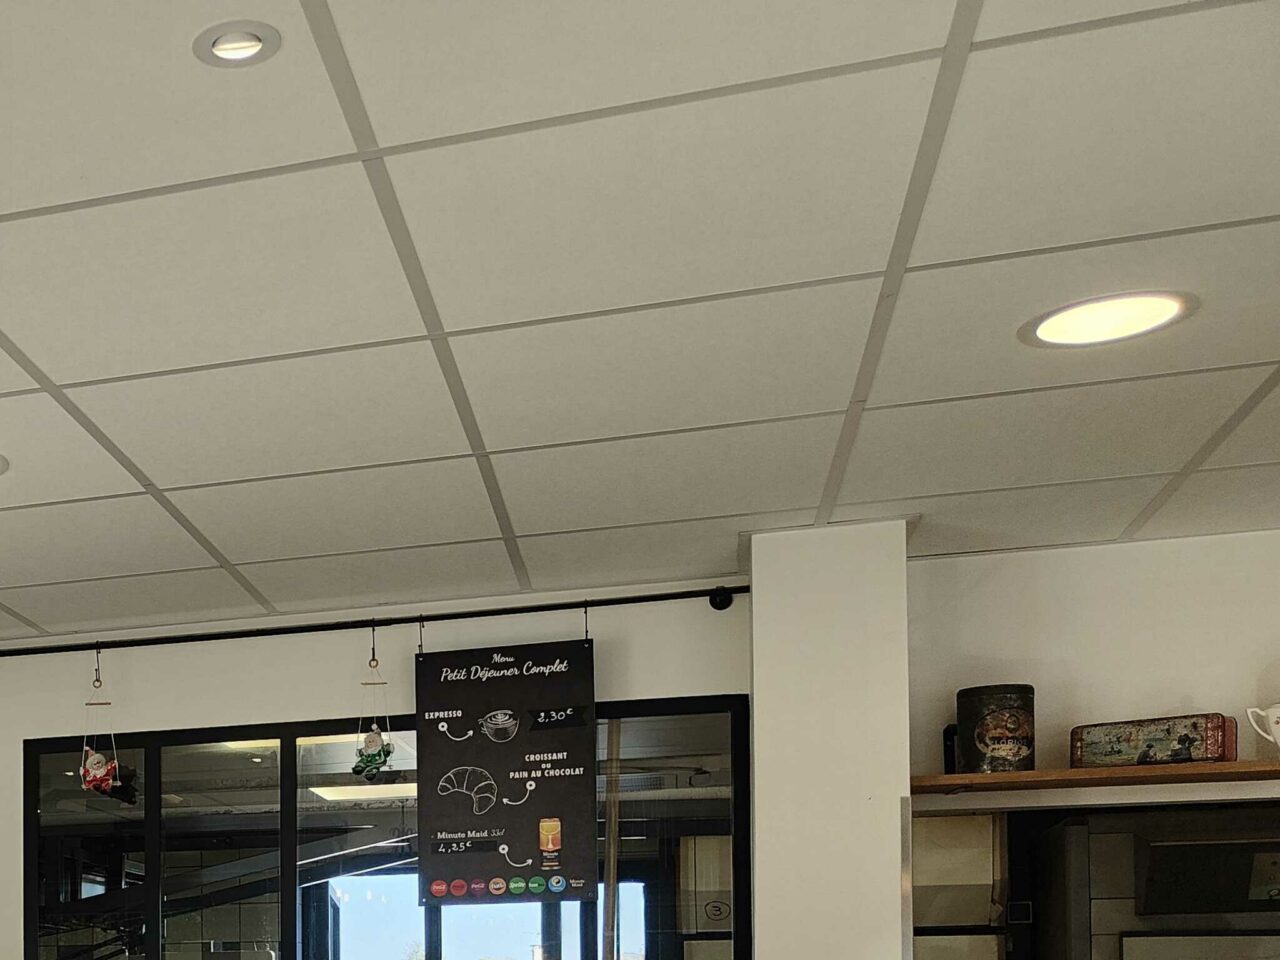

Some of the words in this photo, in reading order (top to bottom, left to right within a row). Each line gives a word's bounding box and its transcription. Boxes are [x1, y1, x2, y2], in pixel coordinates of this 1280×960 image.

[492, 653, 515, 664] Menu
[441, 665, 467, 682] Petit
[470, 664, 520, 681] Déjeuner
[523, 659, 569, 675] Complet
[425, 710, 462, 719] EXPRESSO
[525, 752, 568, 762] CROISSANT
[509, 770, 528, 779] PAIN
[531, 769, 542, 778] AU
[544, 767, 584, 777] CHOCOLAT
[437, 830, 466, 840] Minute
[468, 829, 488, 838] Maid
